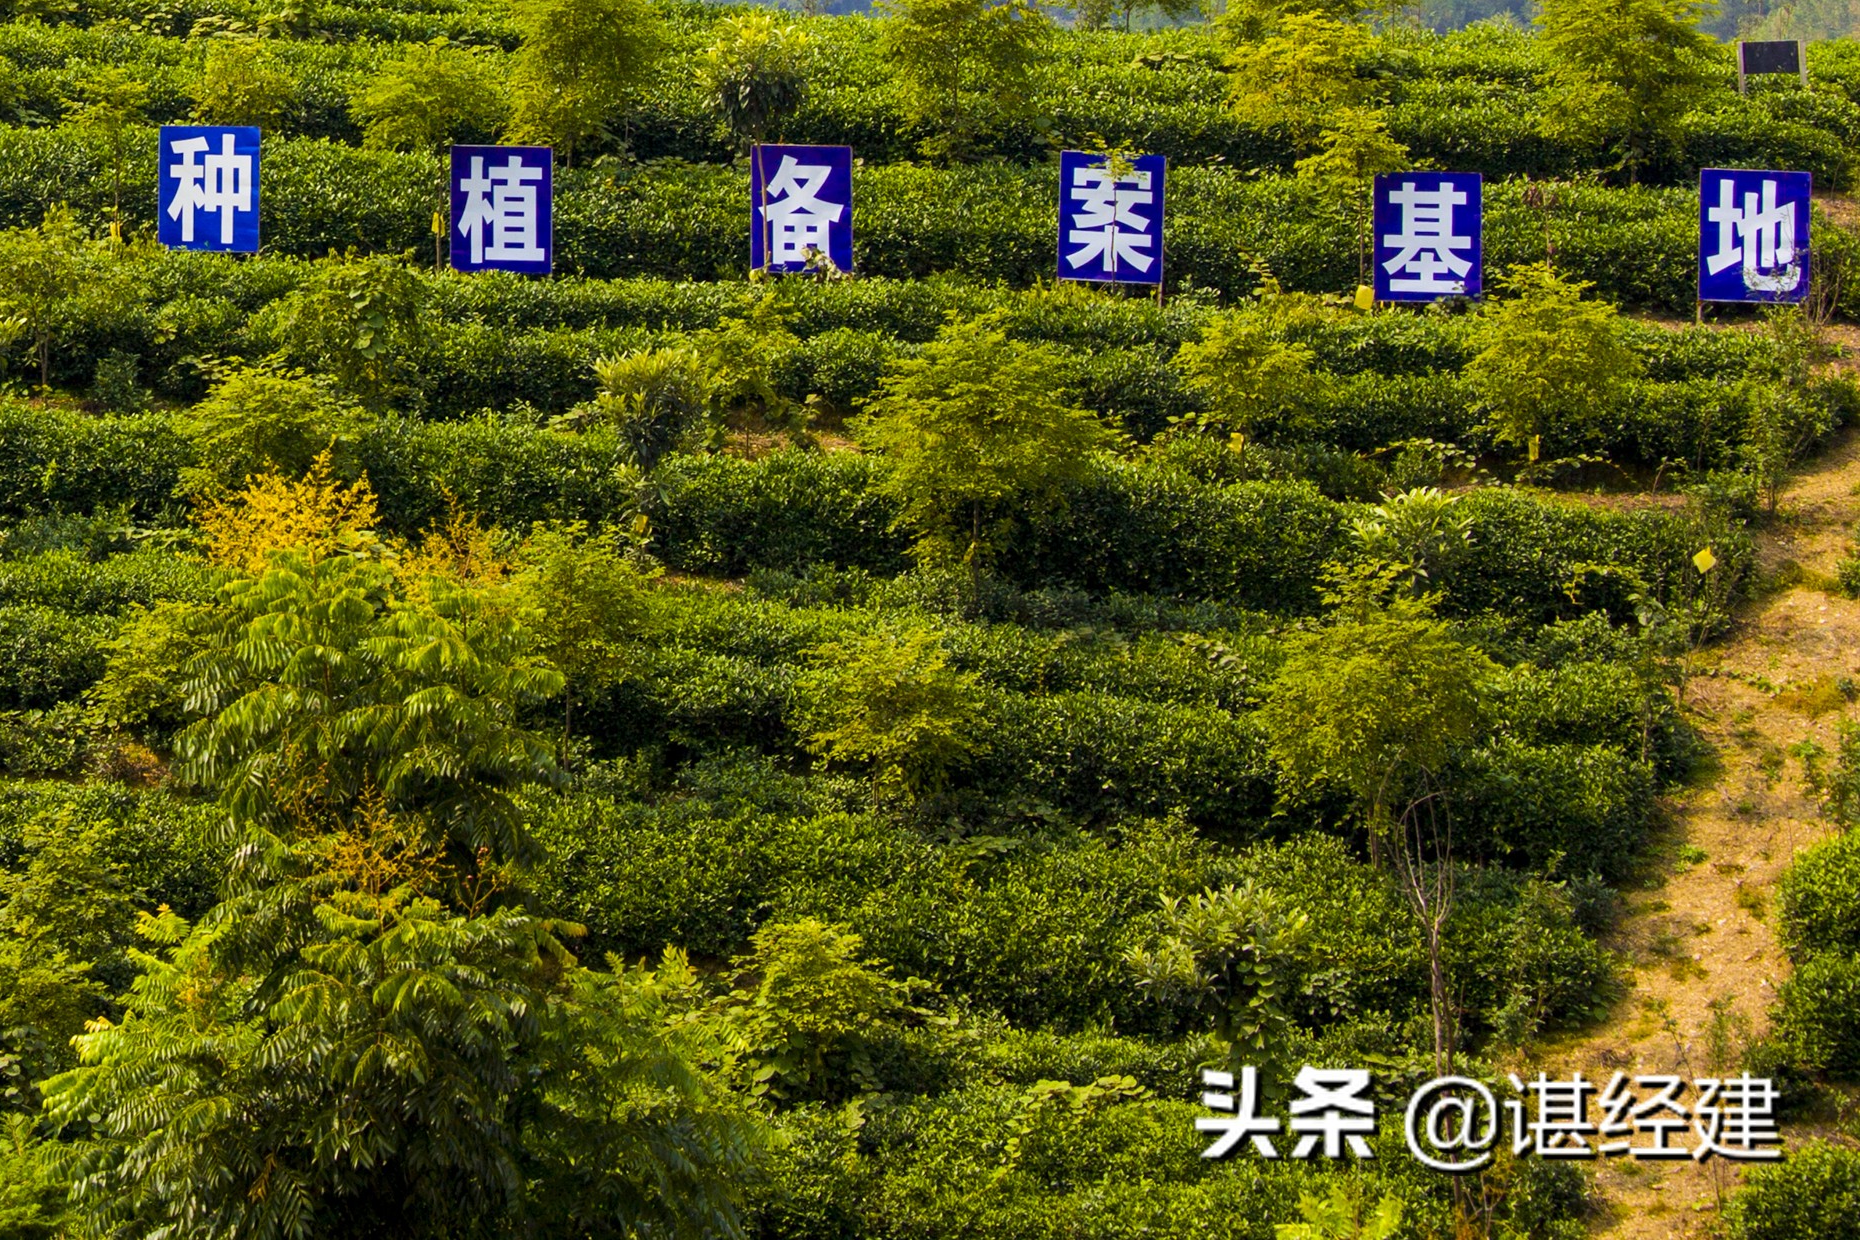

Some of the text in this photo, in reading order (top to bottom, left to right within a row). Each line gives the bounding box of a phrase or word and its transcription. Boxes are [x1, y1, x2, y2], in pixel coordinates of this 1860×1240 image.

[168, 134, 251, 243] 种
[458, 156, 544, 263] 植
[759, 155, 843, 266] 备
[1067, 160, 1153, 273] 案
[1383, 183, 1472, 293] 基
[1707, 180, 1801, 293] 地
